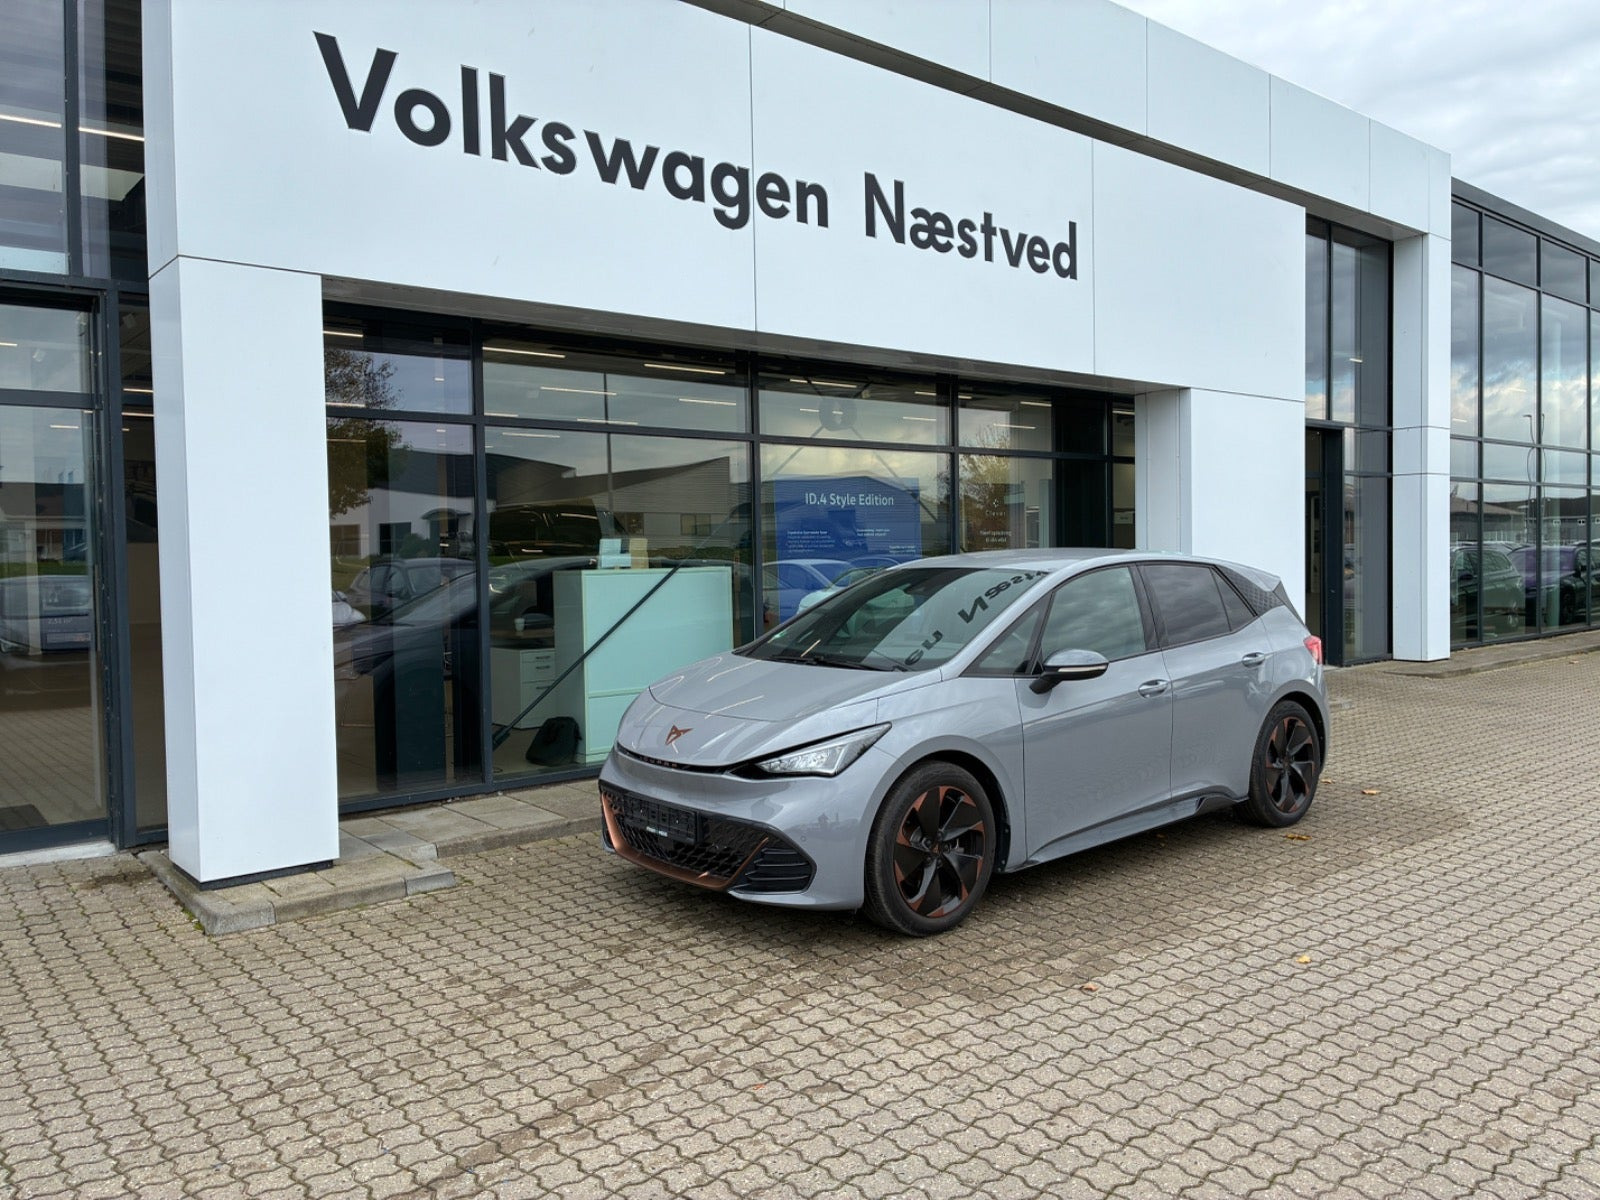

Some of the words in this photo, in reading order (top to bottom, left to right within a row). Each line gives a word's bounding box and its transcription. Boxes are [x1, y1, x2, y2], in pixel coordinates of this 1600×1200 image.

[312, 30, 829, 230] Volkswagen
[864, 171, 1078, 281] Næstved
[804, 492, 827, 505] ID.4
[829, 493, 856, 509] Style
[858, 493, 894, 506] Edition
